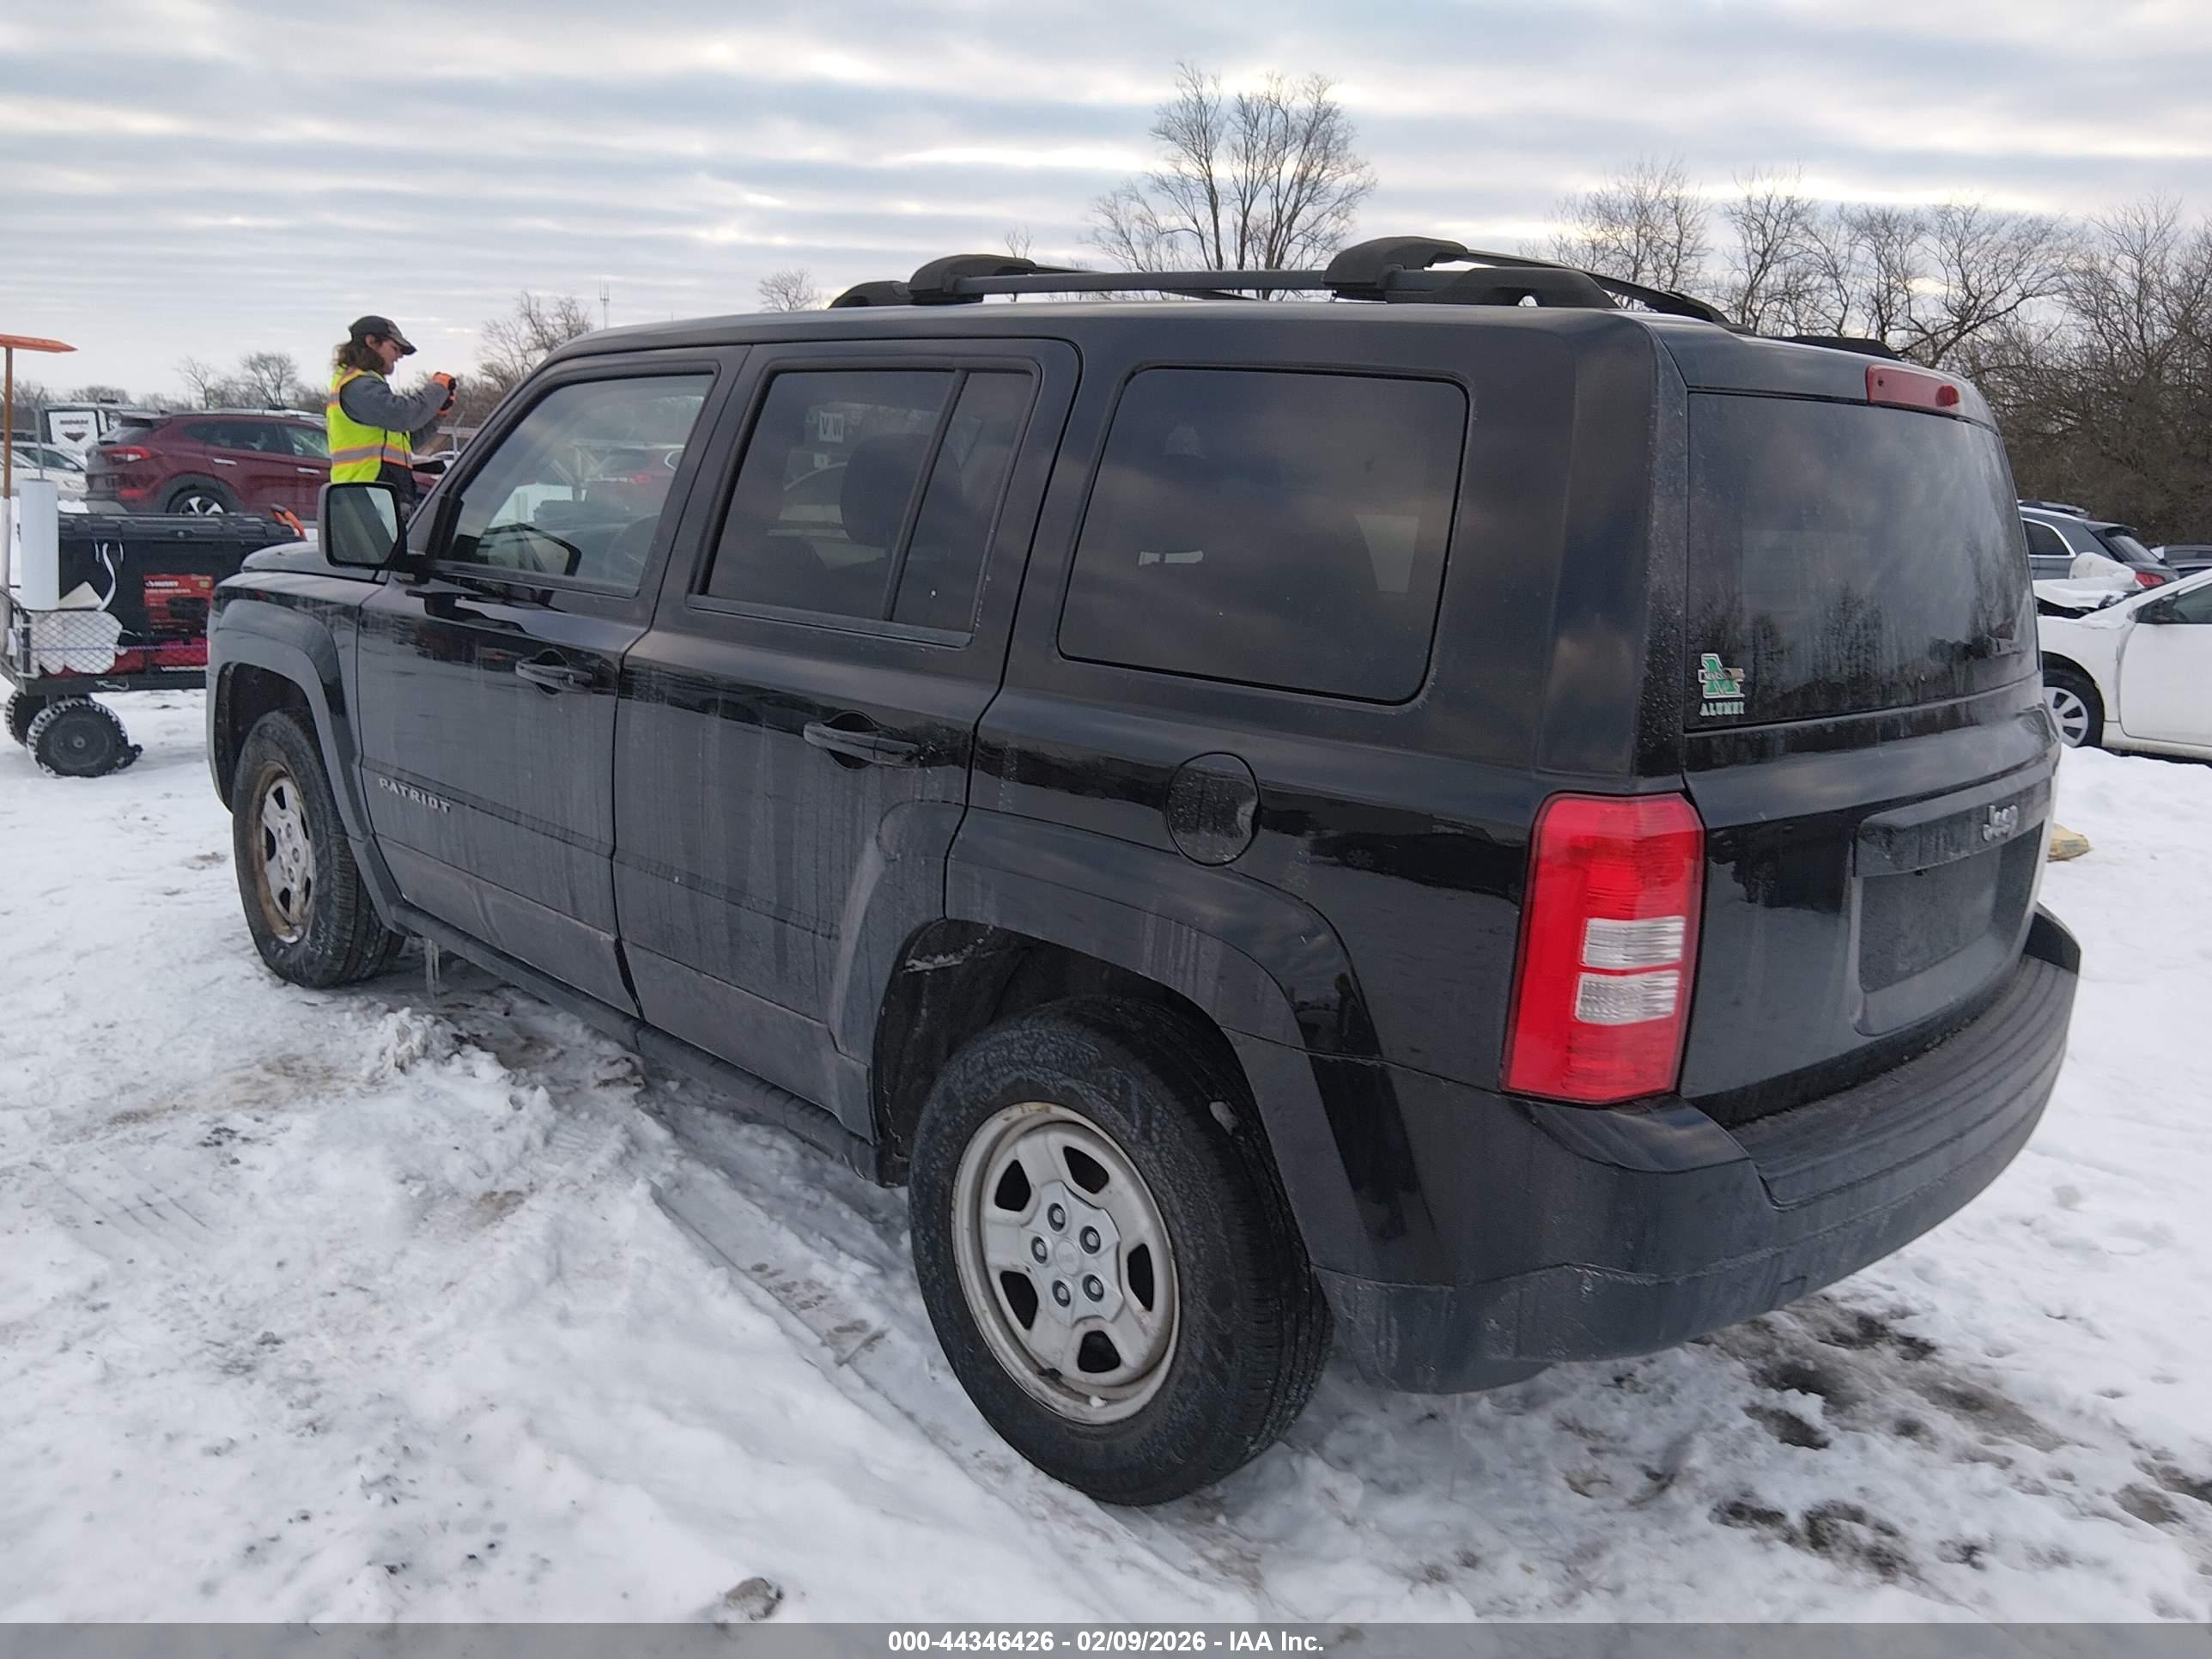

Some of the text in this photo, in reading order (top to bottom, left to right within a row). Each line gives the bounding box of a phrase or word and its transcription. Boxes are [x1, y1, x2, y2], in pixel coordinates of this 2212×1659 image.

[1699, 701, 1745, 716] ALUMNI
[379, 777, 452, 814] PATRIOT
[1983, 805, 2020, 842] Jeep
